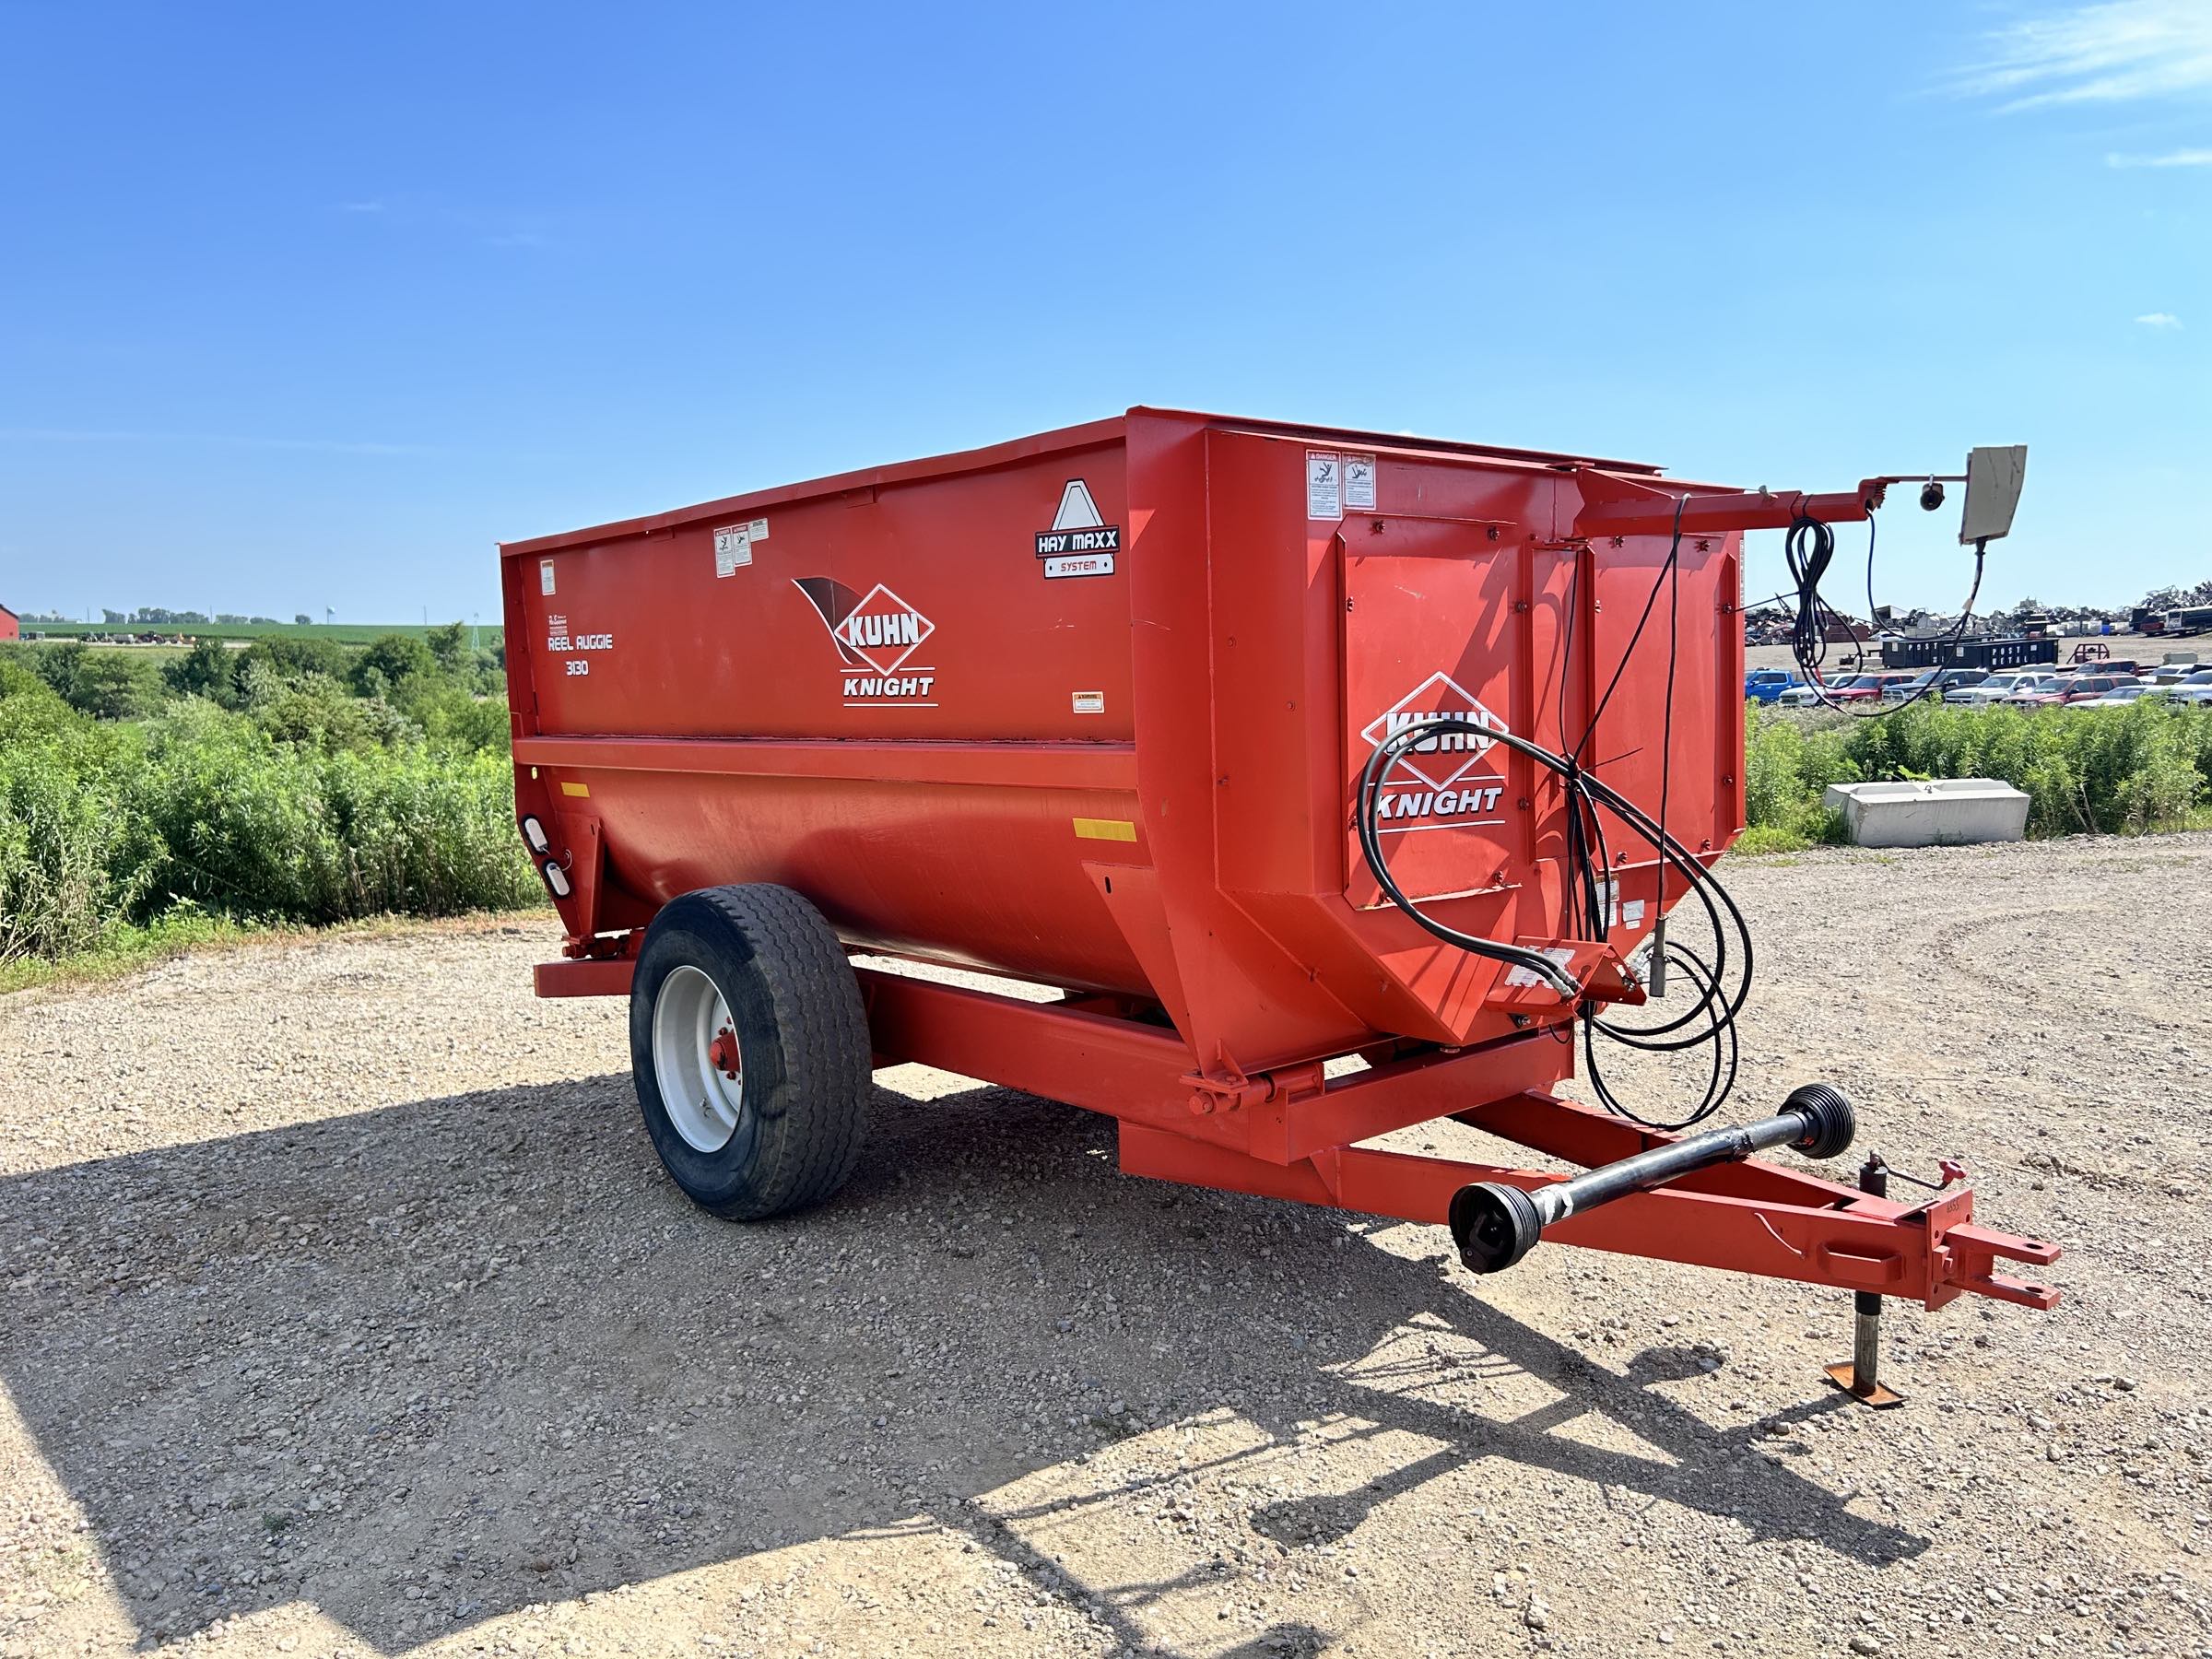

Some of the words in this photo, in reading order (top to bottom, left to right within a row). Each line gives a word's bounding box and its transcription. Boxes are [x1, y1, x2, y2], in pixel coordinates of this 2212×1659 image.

[1038, 535, 1067, 553] HAY
[1072, 531, 1117, 550] MAXX
[1061, 560, 1097, 571] SYSTEM
[848, 612, 920, 648] KUHN
[548, 636, 574, 651] REEL
[576, 634, 613, 650] AUGGIE
[1992, 646, 2020, 655] POST
[566, 660, 589, 676] 3130
[843, 677, 935, 697] KNIGHT
[1386, 711, 1489, 753] KUHN
[1377, 787, 1503, 818] KNIGHT
